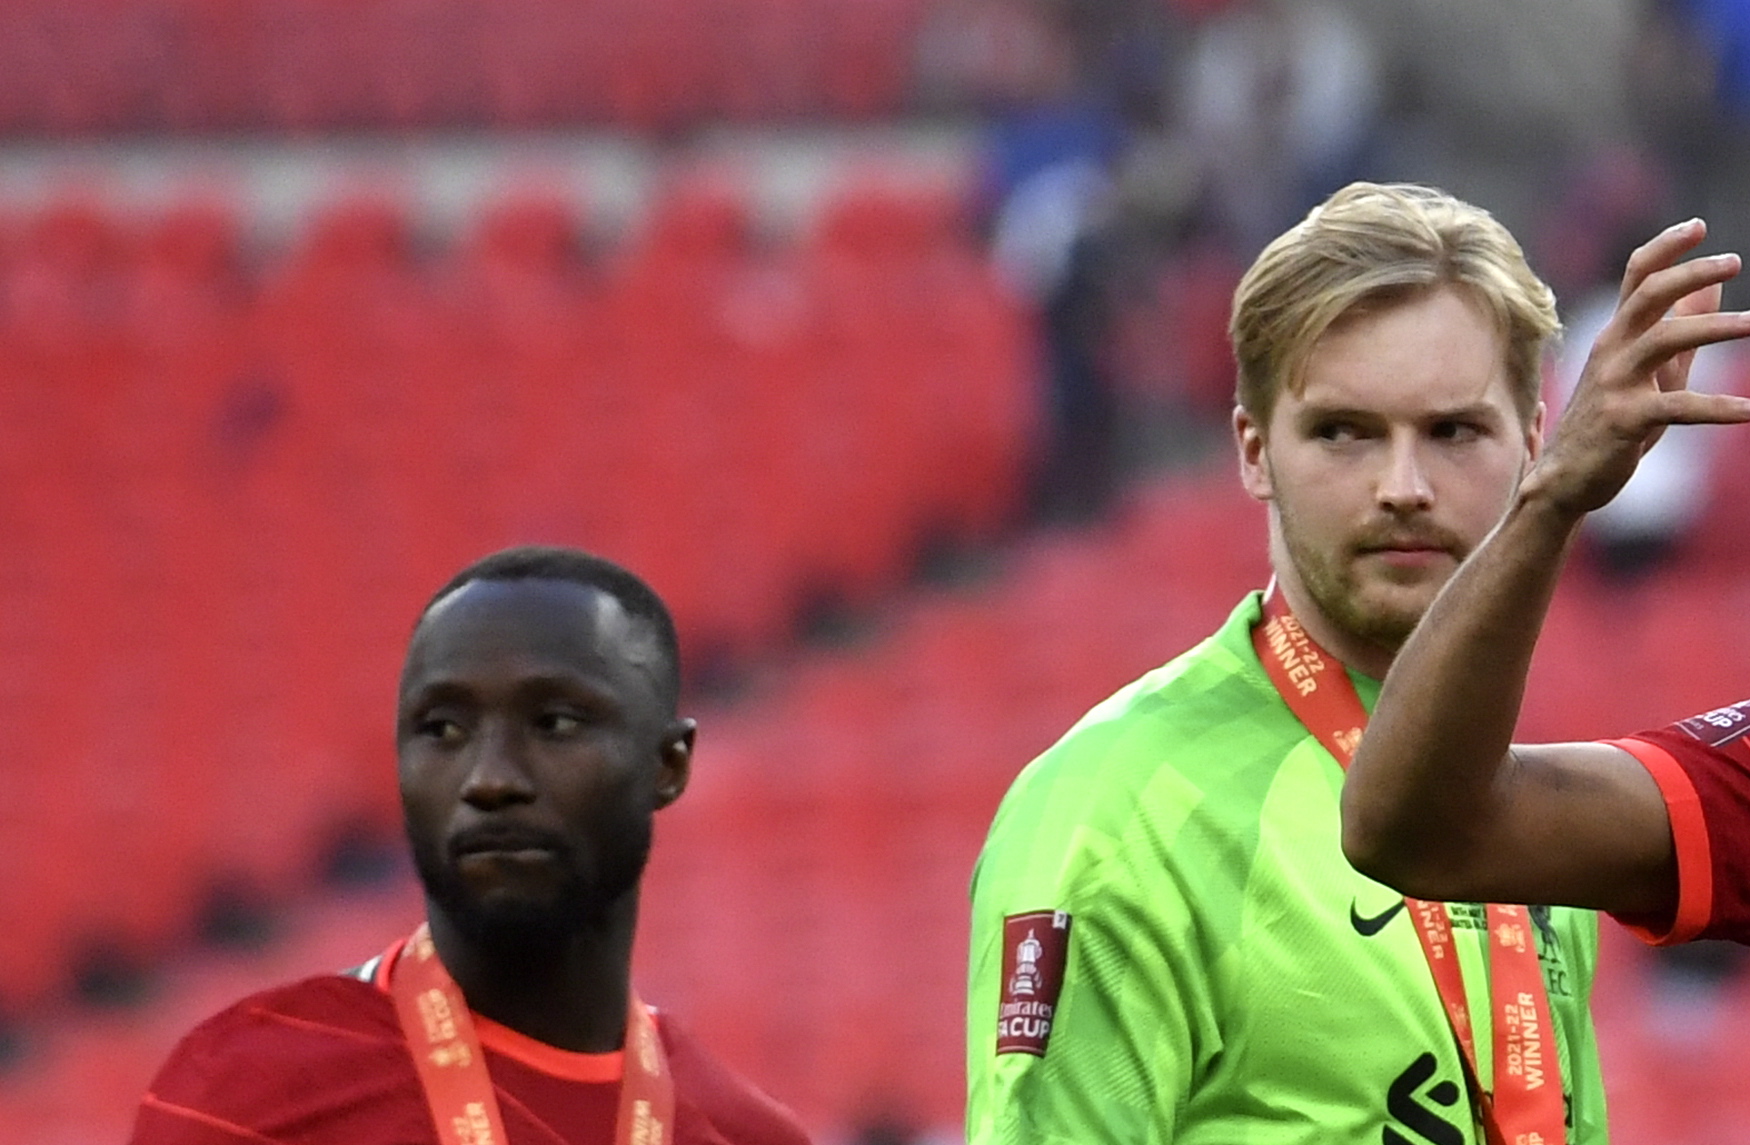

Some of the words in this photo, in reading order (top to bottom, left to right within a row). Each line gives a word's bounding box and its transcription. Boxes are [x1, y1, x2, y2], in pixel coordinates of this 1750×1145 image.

[1009, 1016, 1050, 1039] CUP
[1505, 1004, 1523, 1076] 2021-22
[1518, 992, 1545, 1091] WINNER
